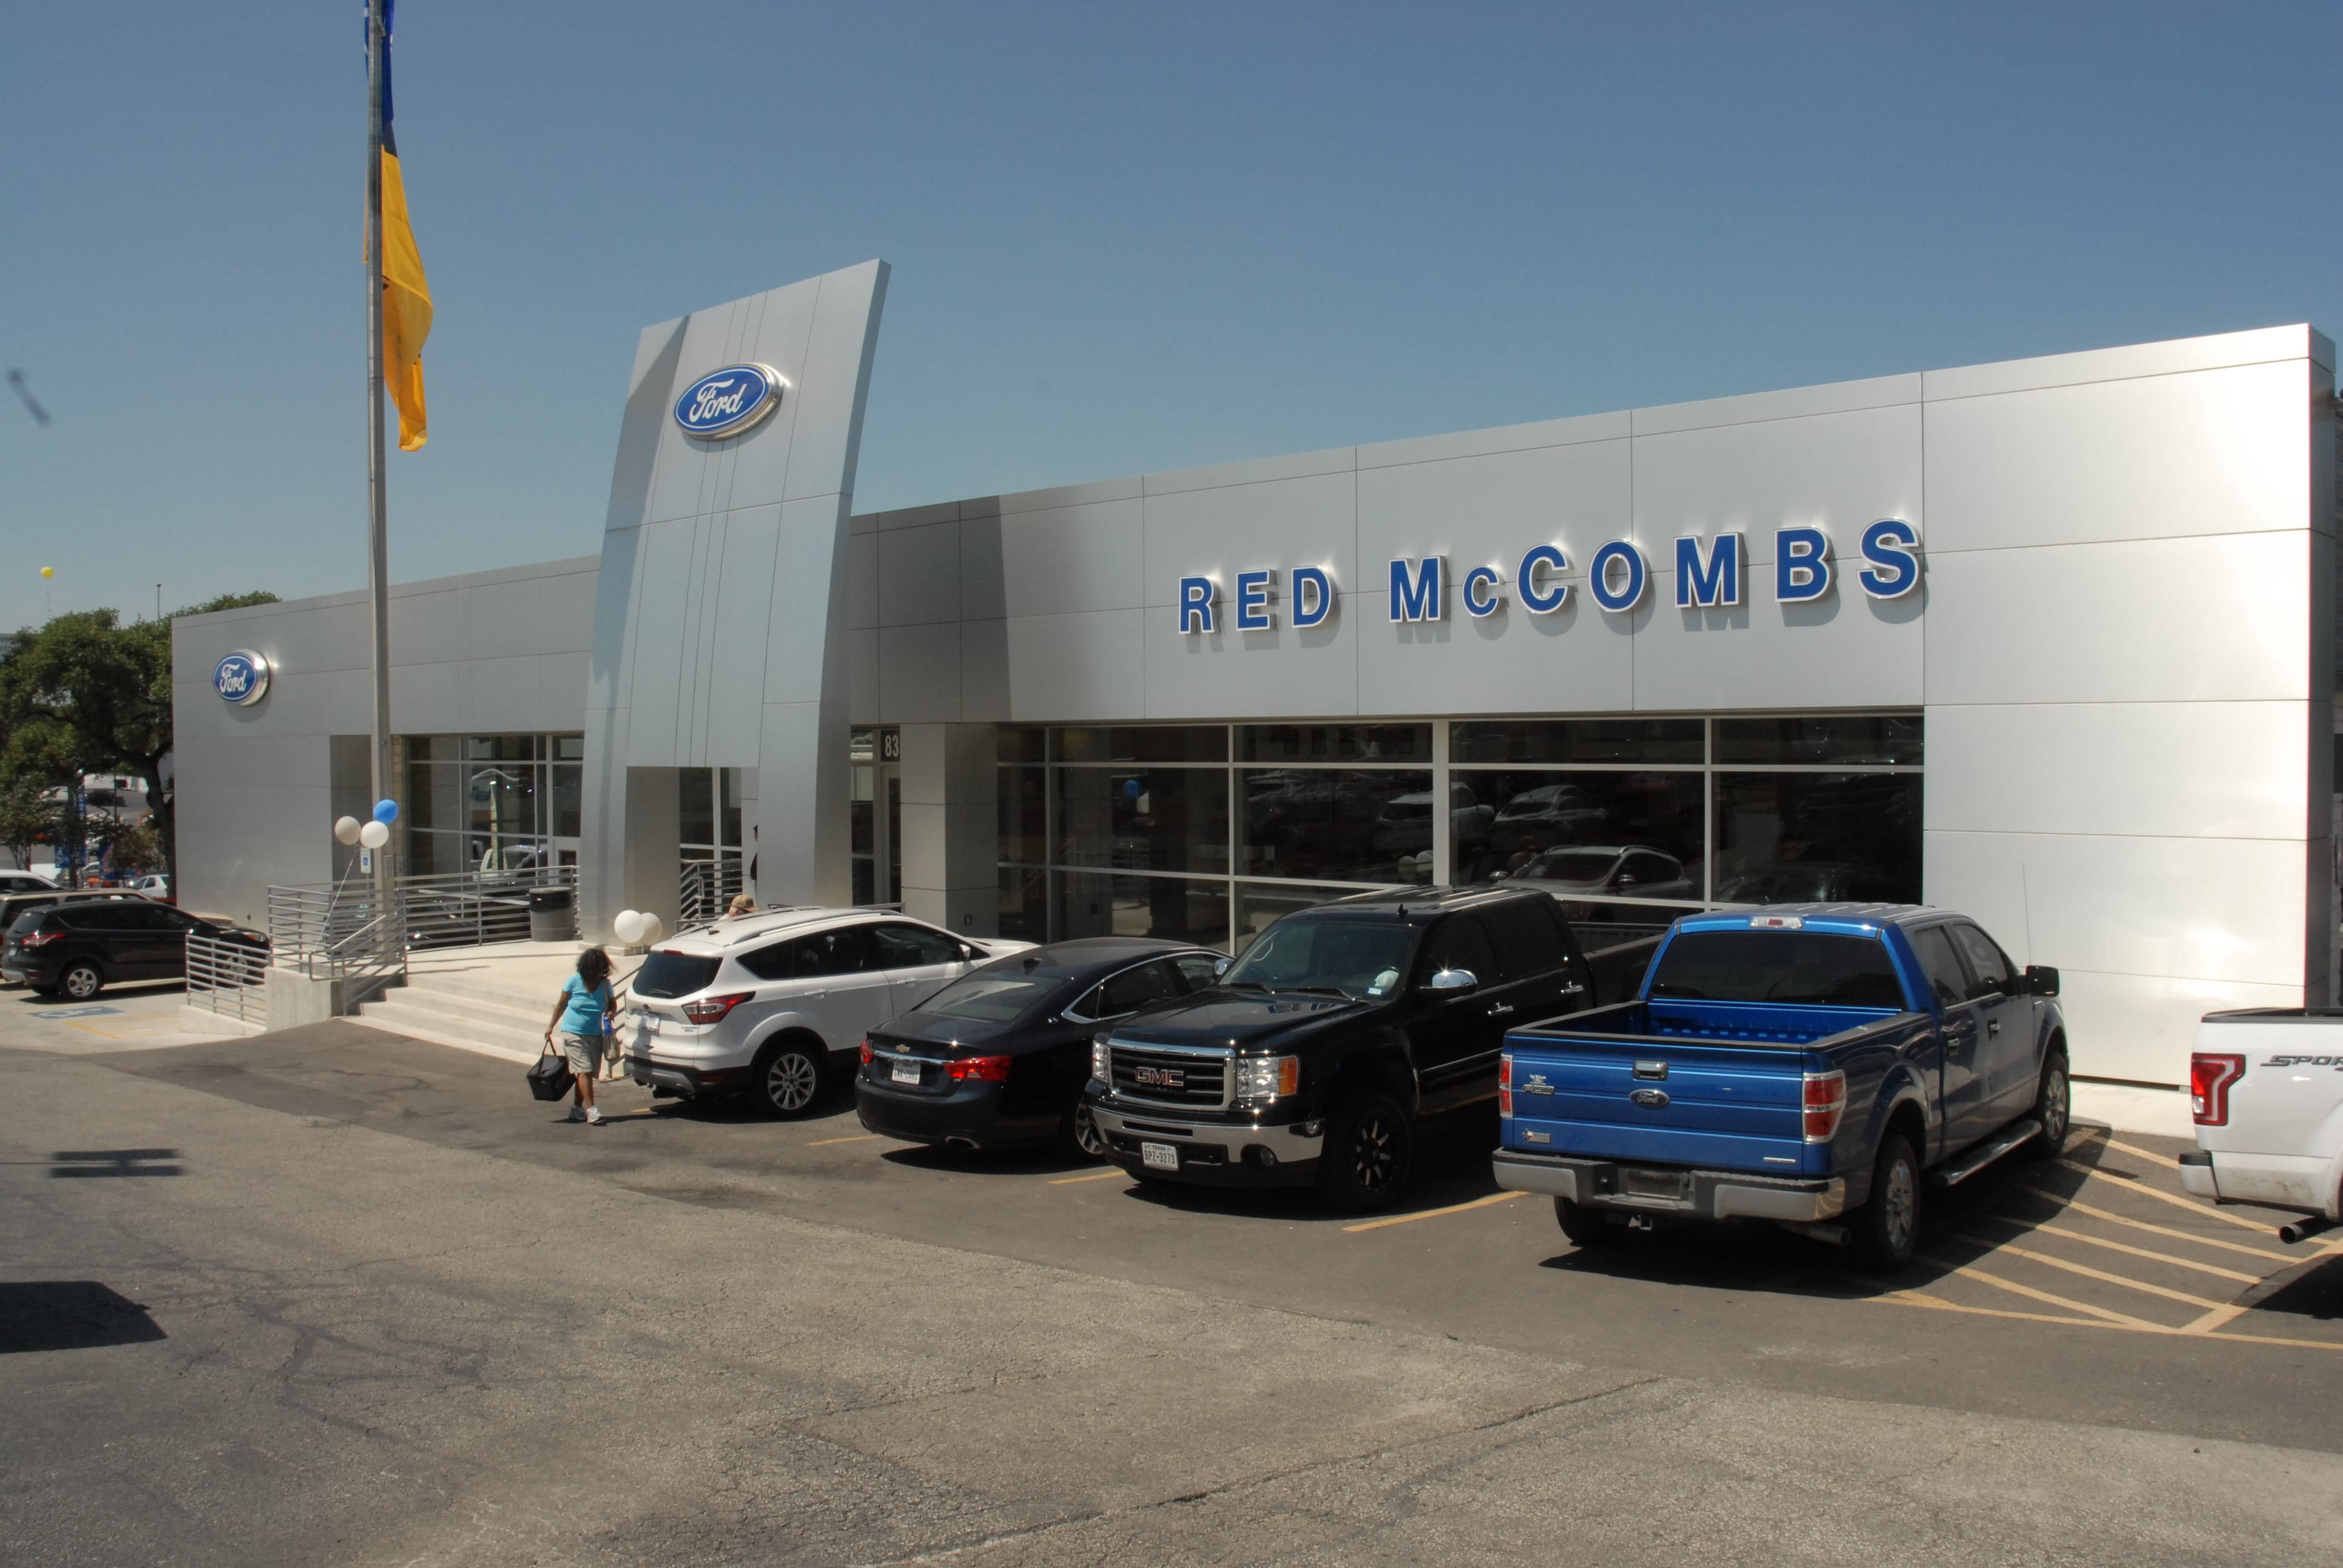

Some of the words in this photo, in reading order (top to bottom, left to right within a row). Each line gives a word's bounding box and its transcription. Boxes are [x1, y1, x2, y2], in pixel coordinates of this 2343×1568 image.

[689, 379, 747, 422] Ford
[1179, 565, 1332, 635] RED
[220, 664, 247, 693] Ford
[1135, 1067, 1184, 1086] GMC
[1637, 1093, 1658, 1103] Ford
